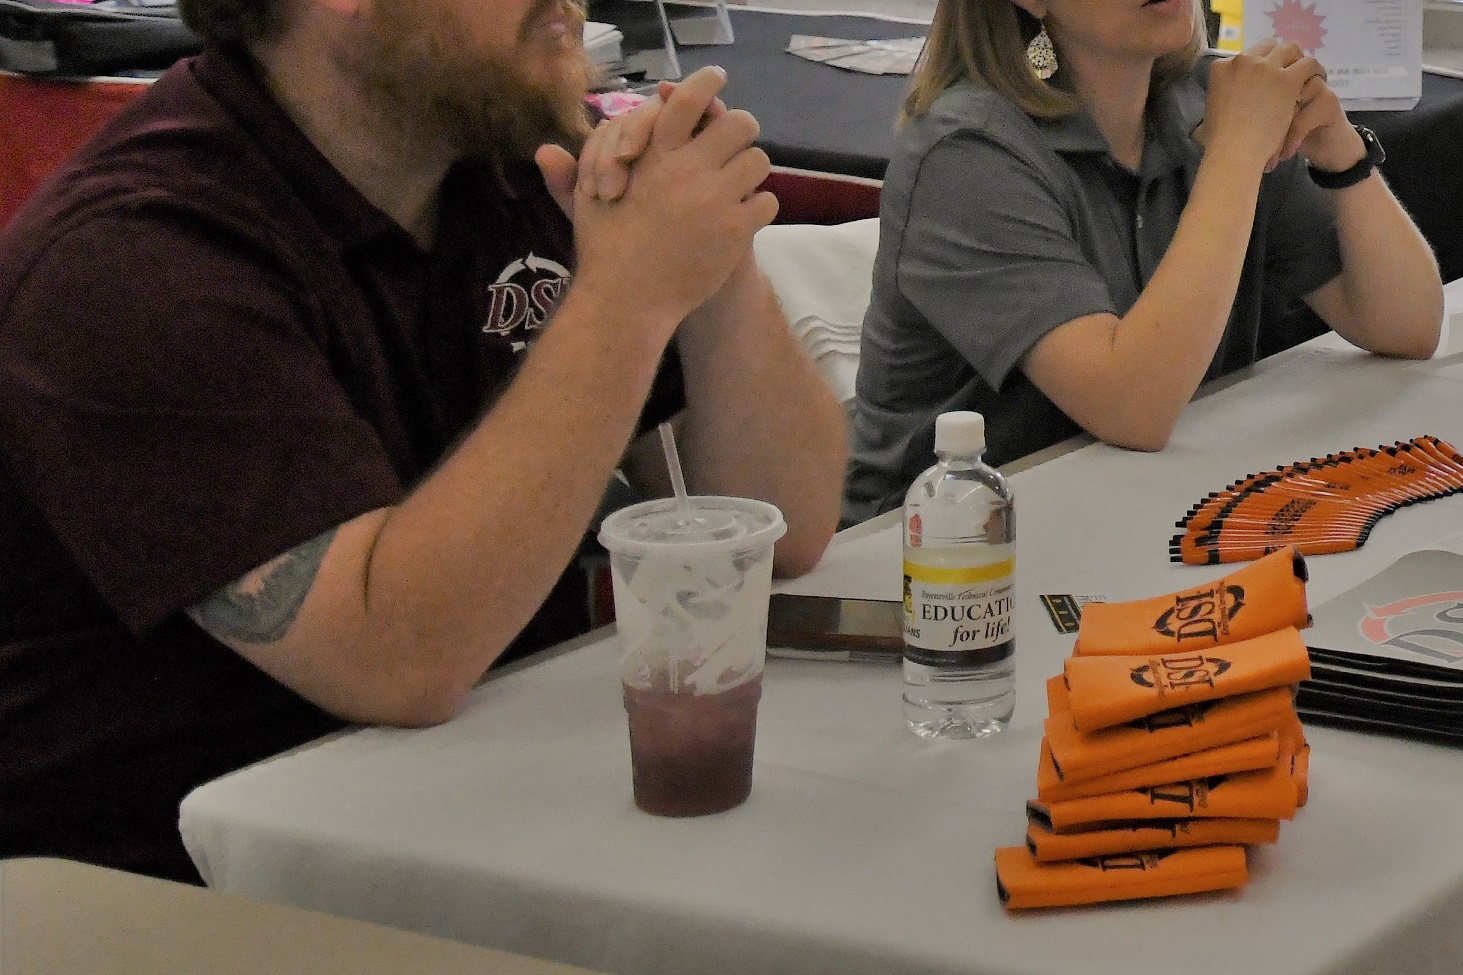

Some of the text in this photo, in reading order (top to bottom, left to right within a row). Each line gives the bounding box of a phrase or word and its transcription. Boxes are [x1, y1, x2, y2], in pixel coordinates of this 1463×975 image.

[482, 277, 572, 333] DS
[948, 616, 1011, 648] for life!
[1175, 587, 1219, 643] DSI
[1160, 655, 1215, 691] DSI
